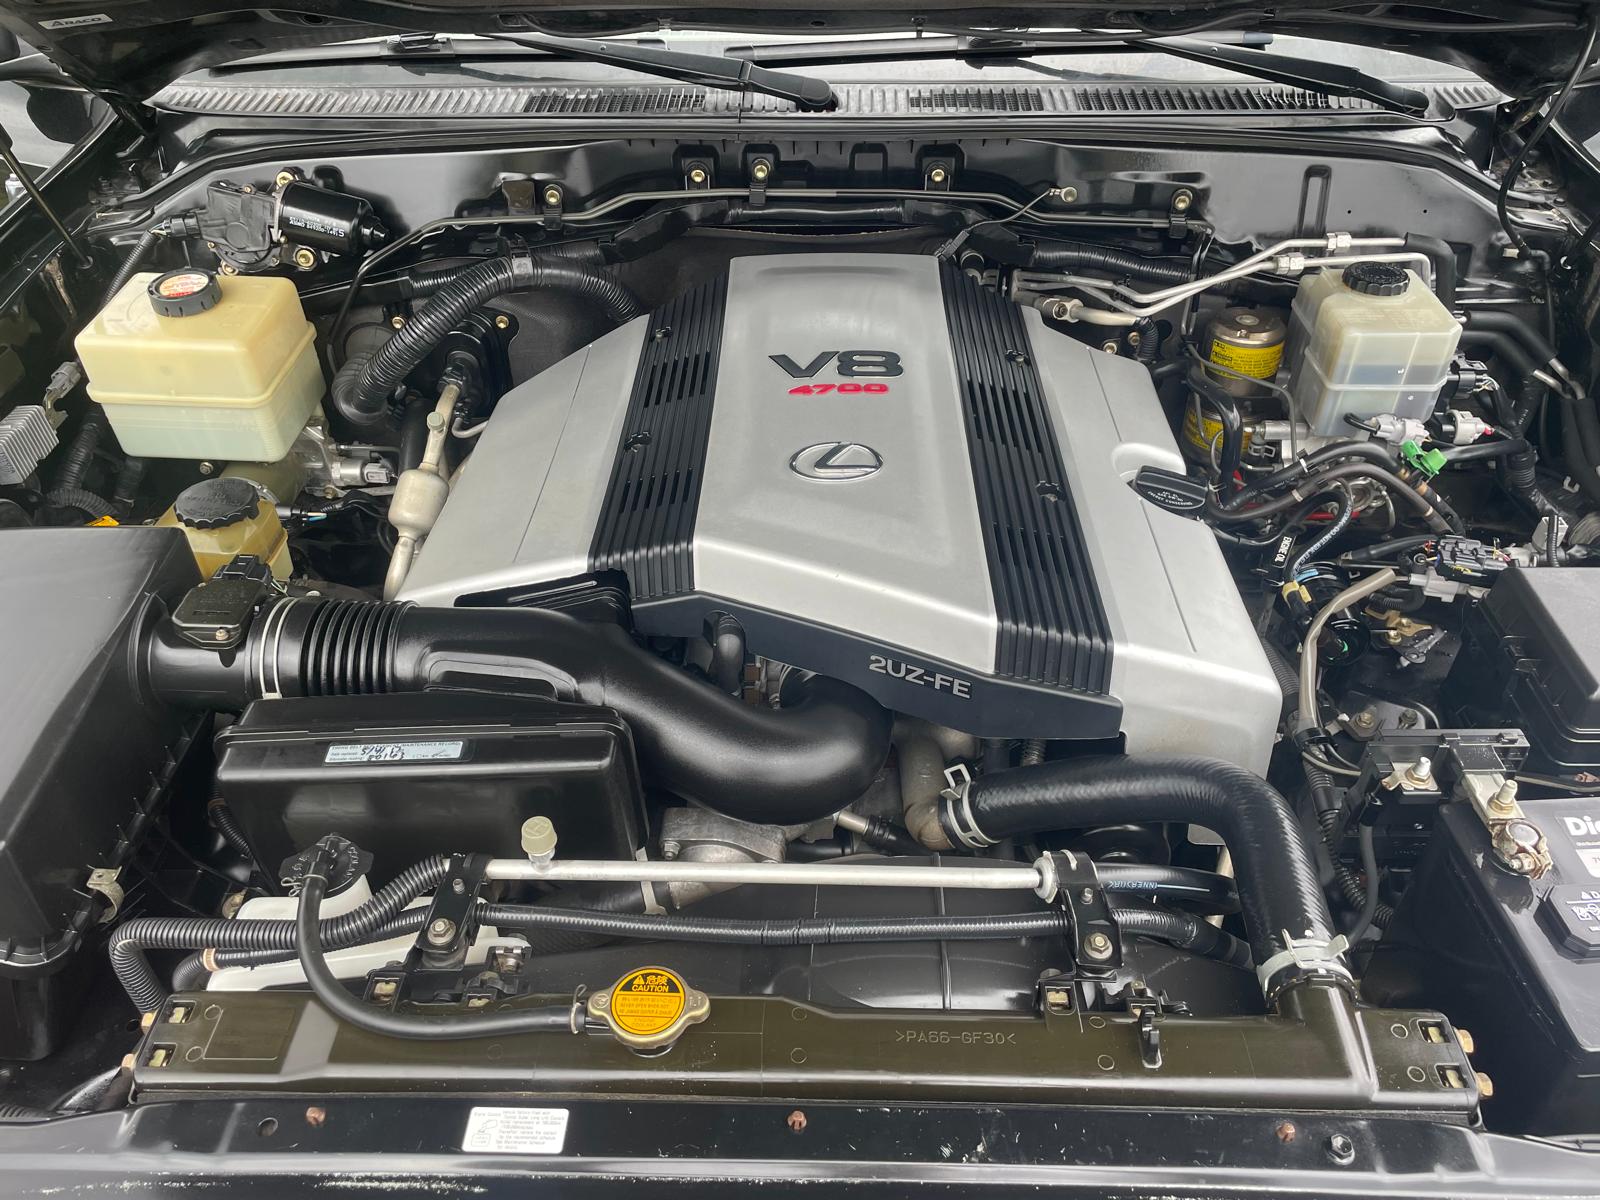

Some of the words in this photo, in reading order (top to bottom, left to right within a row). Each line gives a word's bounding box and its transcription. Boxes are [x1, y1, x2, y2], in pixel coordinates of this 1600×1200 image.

[51, 17, 103, 27] ARACO
[768, 350, 905, 379] V8
[788, 383, 890, 396] 4700
[869, 655, 972, 699] 2UZ-FE
[631, 985, 669, 993] CAUTION
[895, 1030, 1016, 1045] >PA66-GF30<
